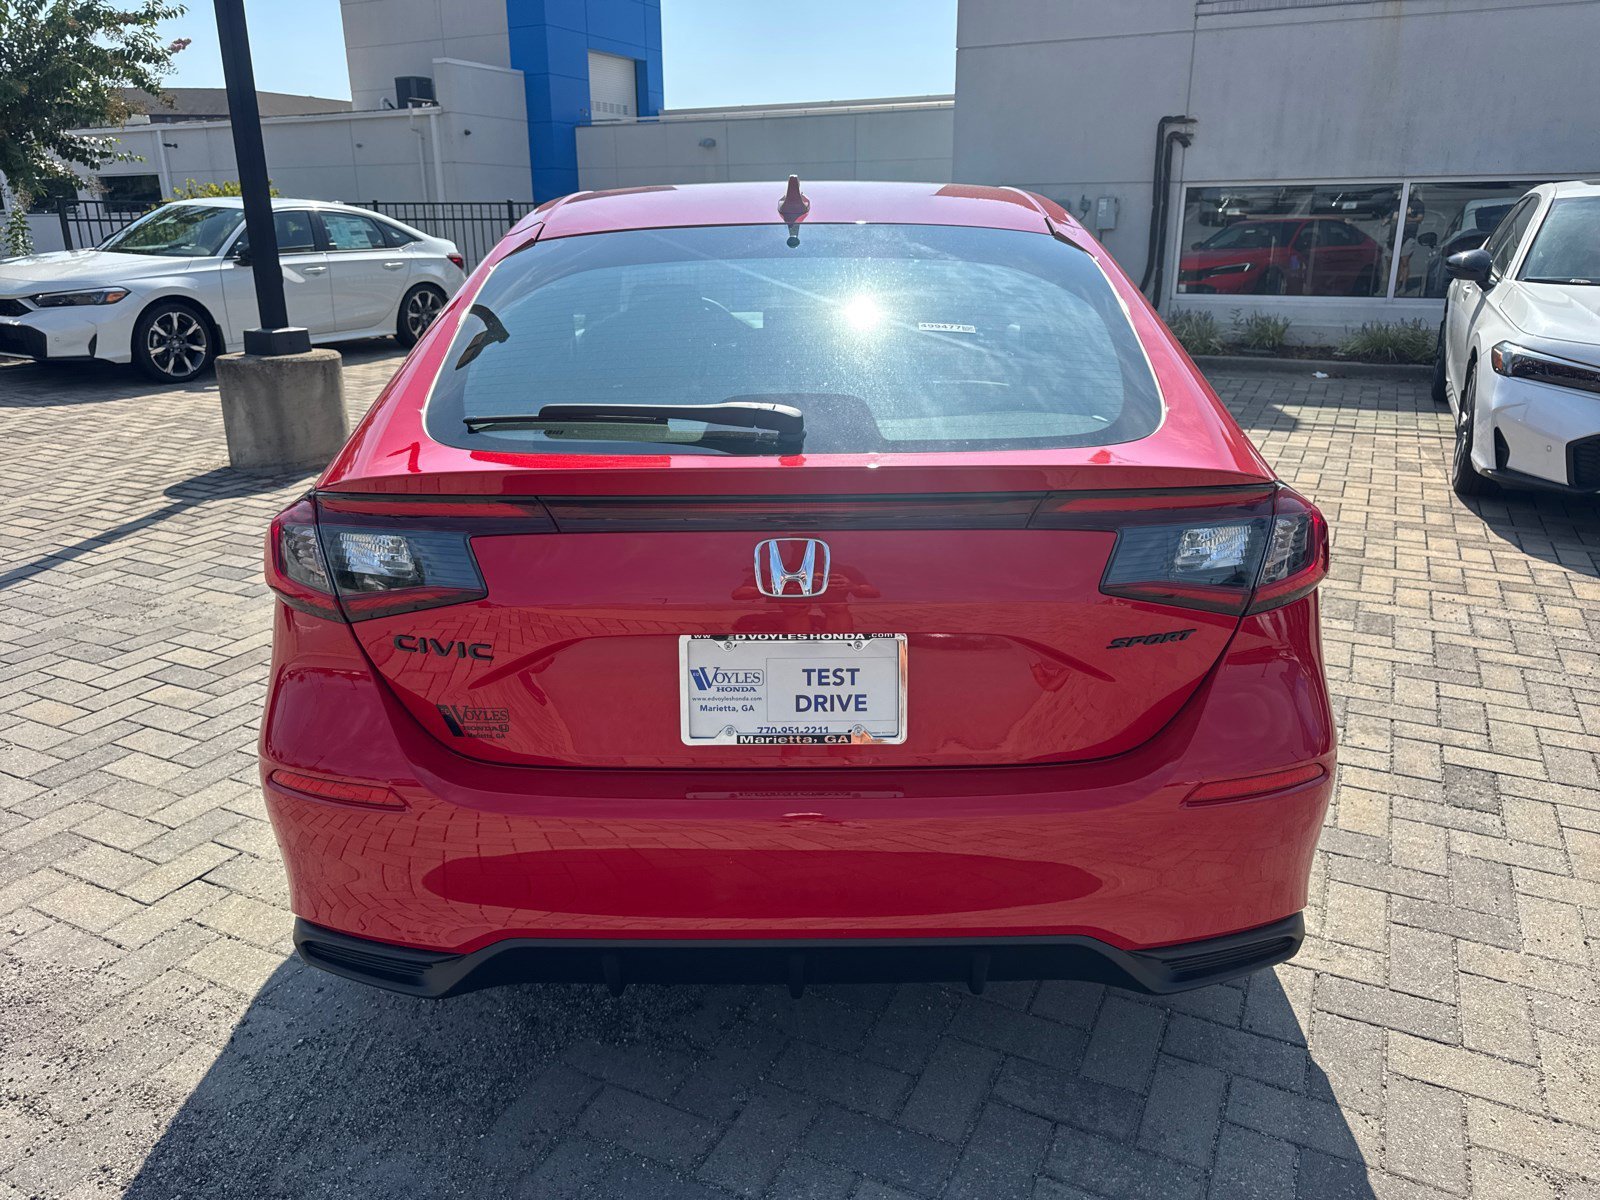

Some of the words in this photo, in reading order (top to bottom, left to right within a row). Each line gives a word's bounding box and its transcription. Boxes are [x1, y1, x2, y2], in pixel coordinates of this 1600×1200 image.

[393, 634, 495, 661] CIVIC
[1106, 628, 1198, 650] SPORT
[699, 666, 762, 689] VOYLES
[802, 667, 861, 686] TEST
[700, 704, 739, 713] Marietta,
[741, 704, 755, 712] GA
[795, 693, 868, 713] DRIVE
[450, 704, 508, 725] VOYLES
[739, 735, 818, 744] Marietta,
[824, 735, 849, 744] GA
